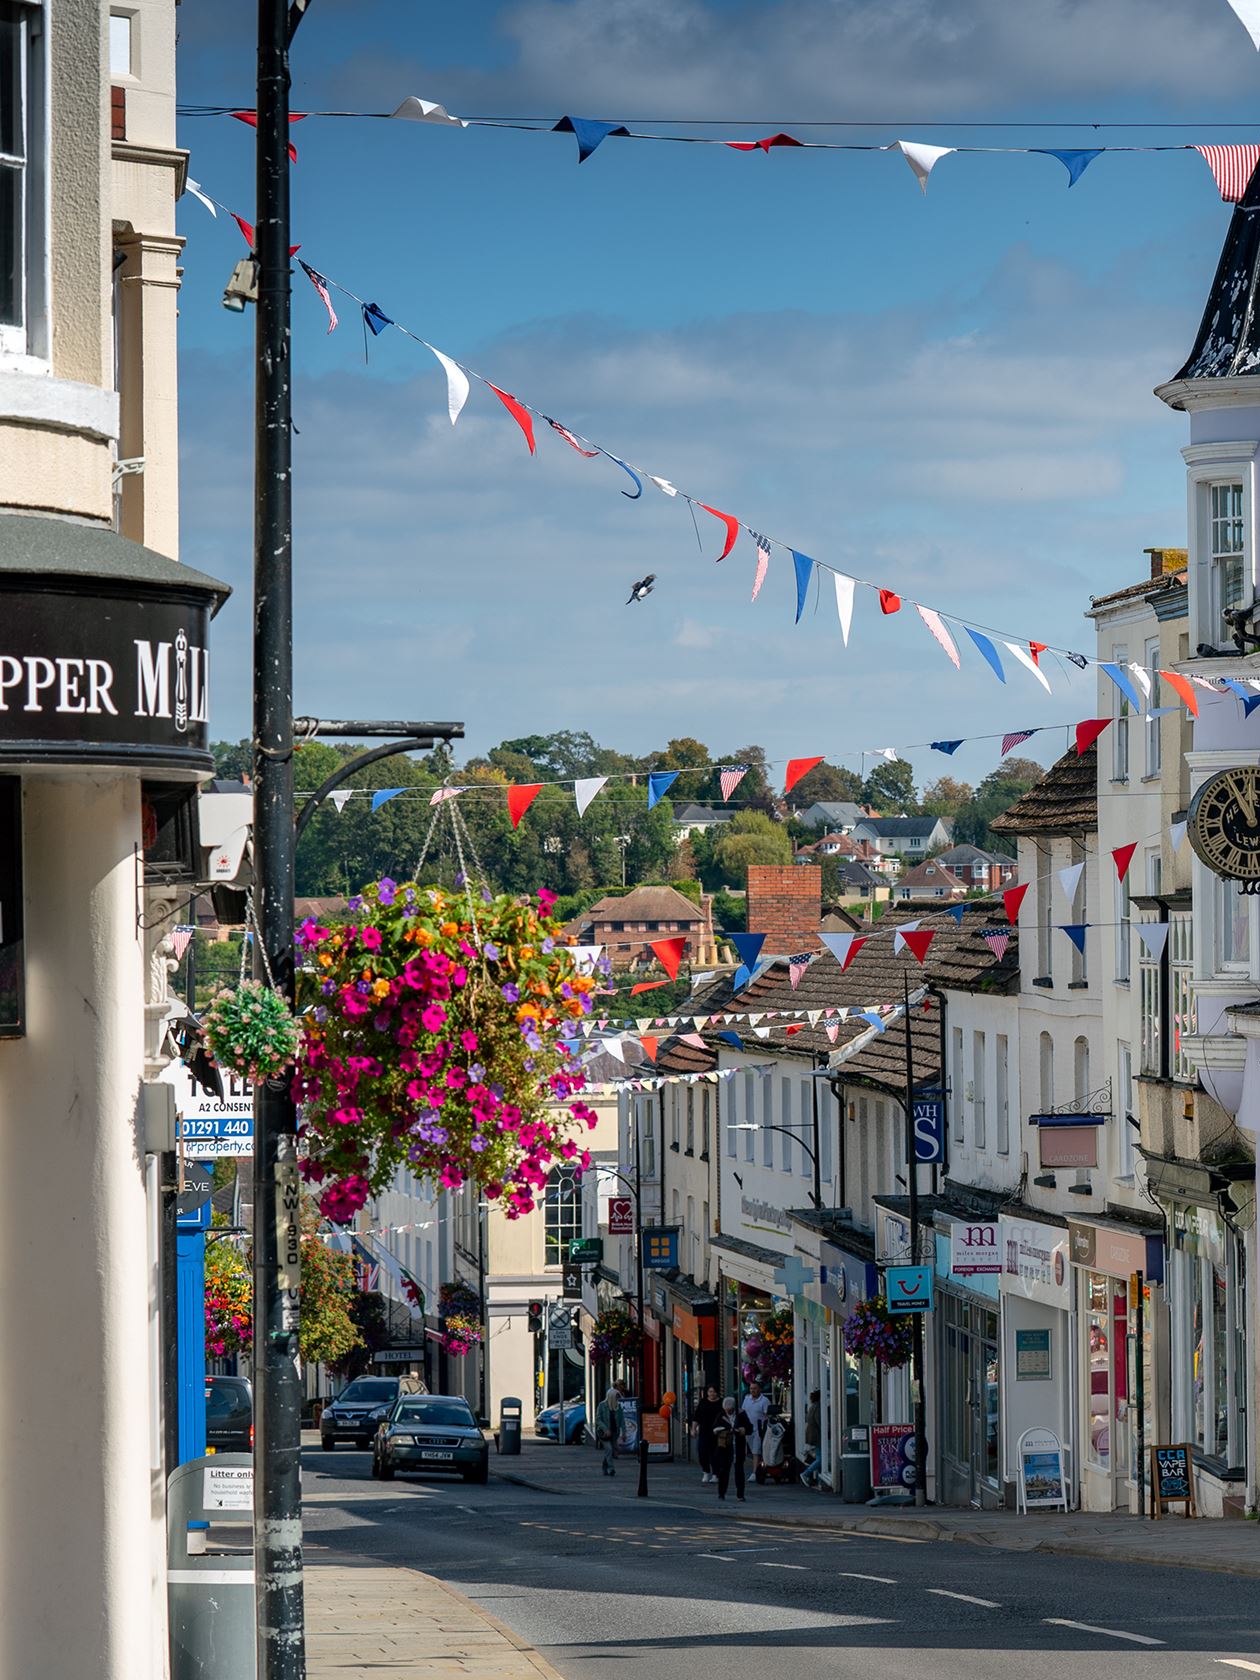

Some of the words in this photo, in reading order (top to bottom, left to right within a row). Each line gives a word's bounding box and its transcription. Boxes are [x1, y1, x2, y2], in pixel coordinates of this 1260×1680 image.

[229, 1074, 254, 1097] LE
[199, 1103, 211, 1112] A2
[913, 1104, 938, 1117] WH
[182, 1121, 219, 1134] 01291
[223, 1121, 249, 1134] 440
[914, 1117, 939, 1160] S
[384, 1351, 413, 1360] HOTEL
[1158, 1460, 1186, 1468] VAPE
[210, 1470, 234, 1478] Litter
[1162, 1468, 1184, 1477] BAR
